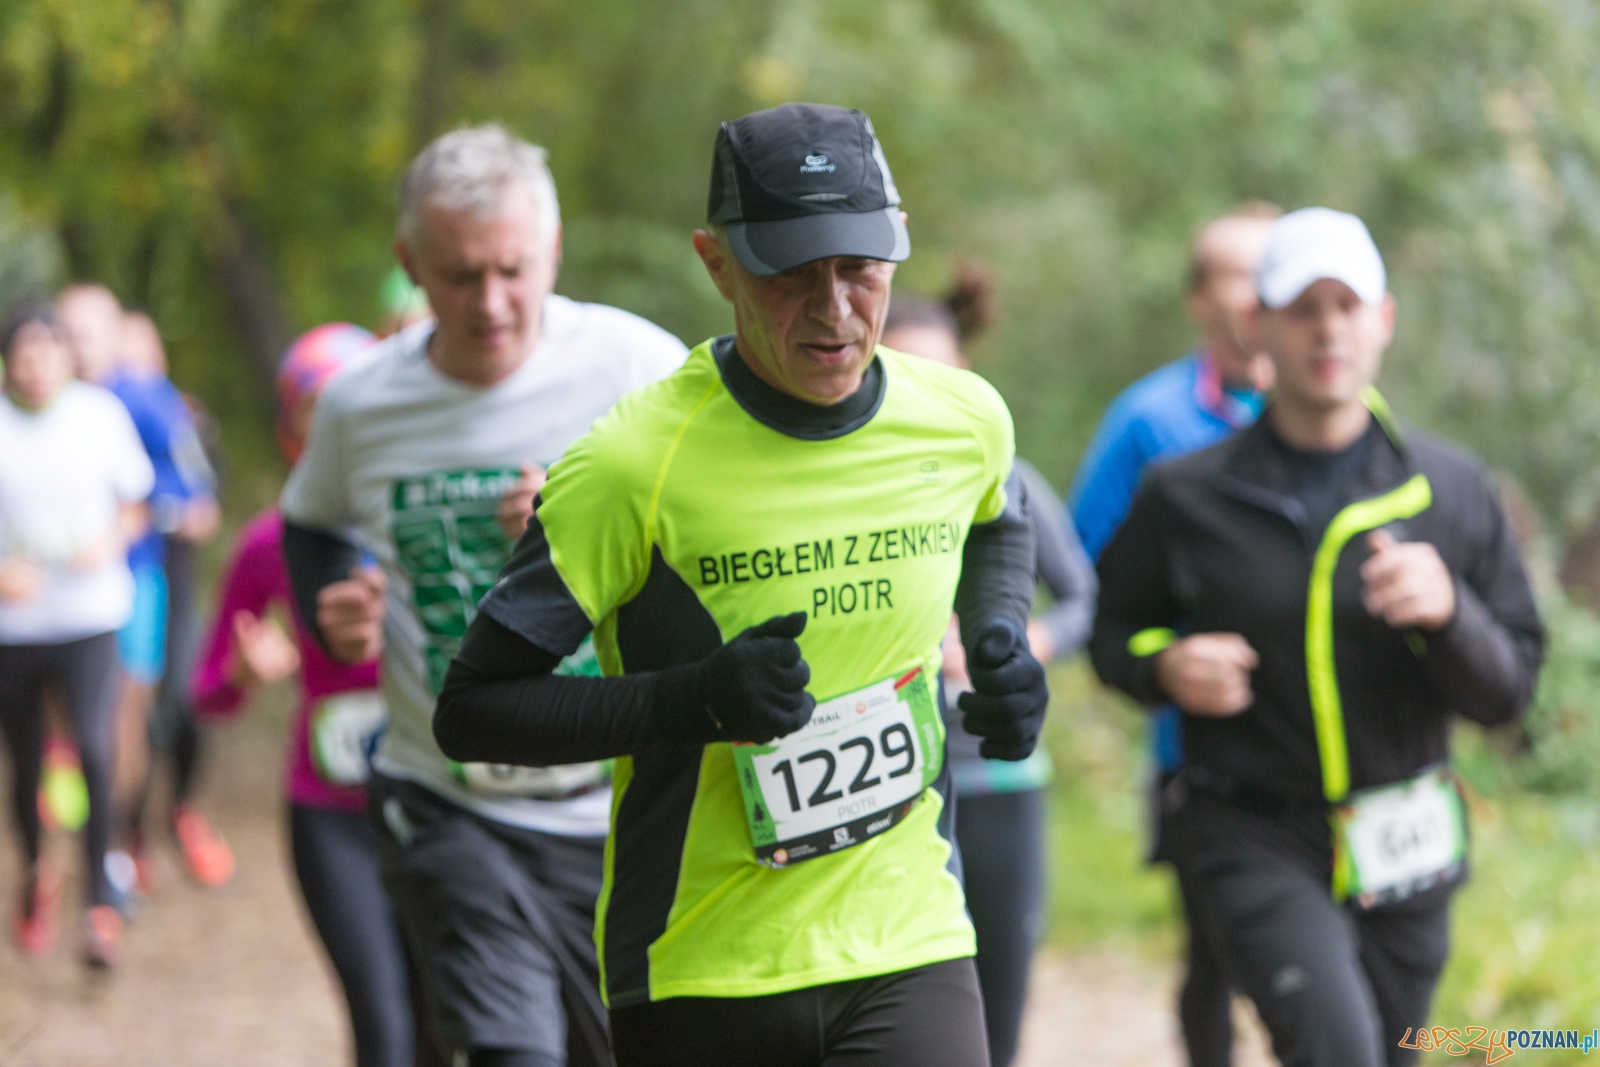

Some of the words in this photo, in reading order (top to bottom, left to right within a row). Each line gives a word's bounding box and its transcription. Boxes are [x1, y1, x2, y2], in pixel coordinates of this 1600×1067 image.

[699, 538, 835, 586] BIEGŁEM
[843, 535, 860, 566] Z
[812, 578, 894, 618] PIOTR
[771, 721, 916, 813] 1229
[837, 796, 877, 820] PIOTR
